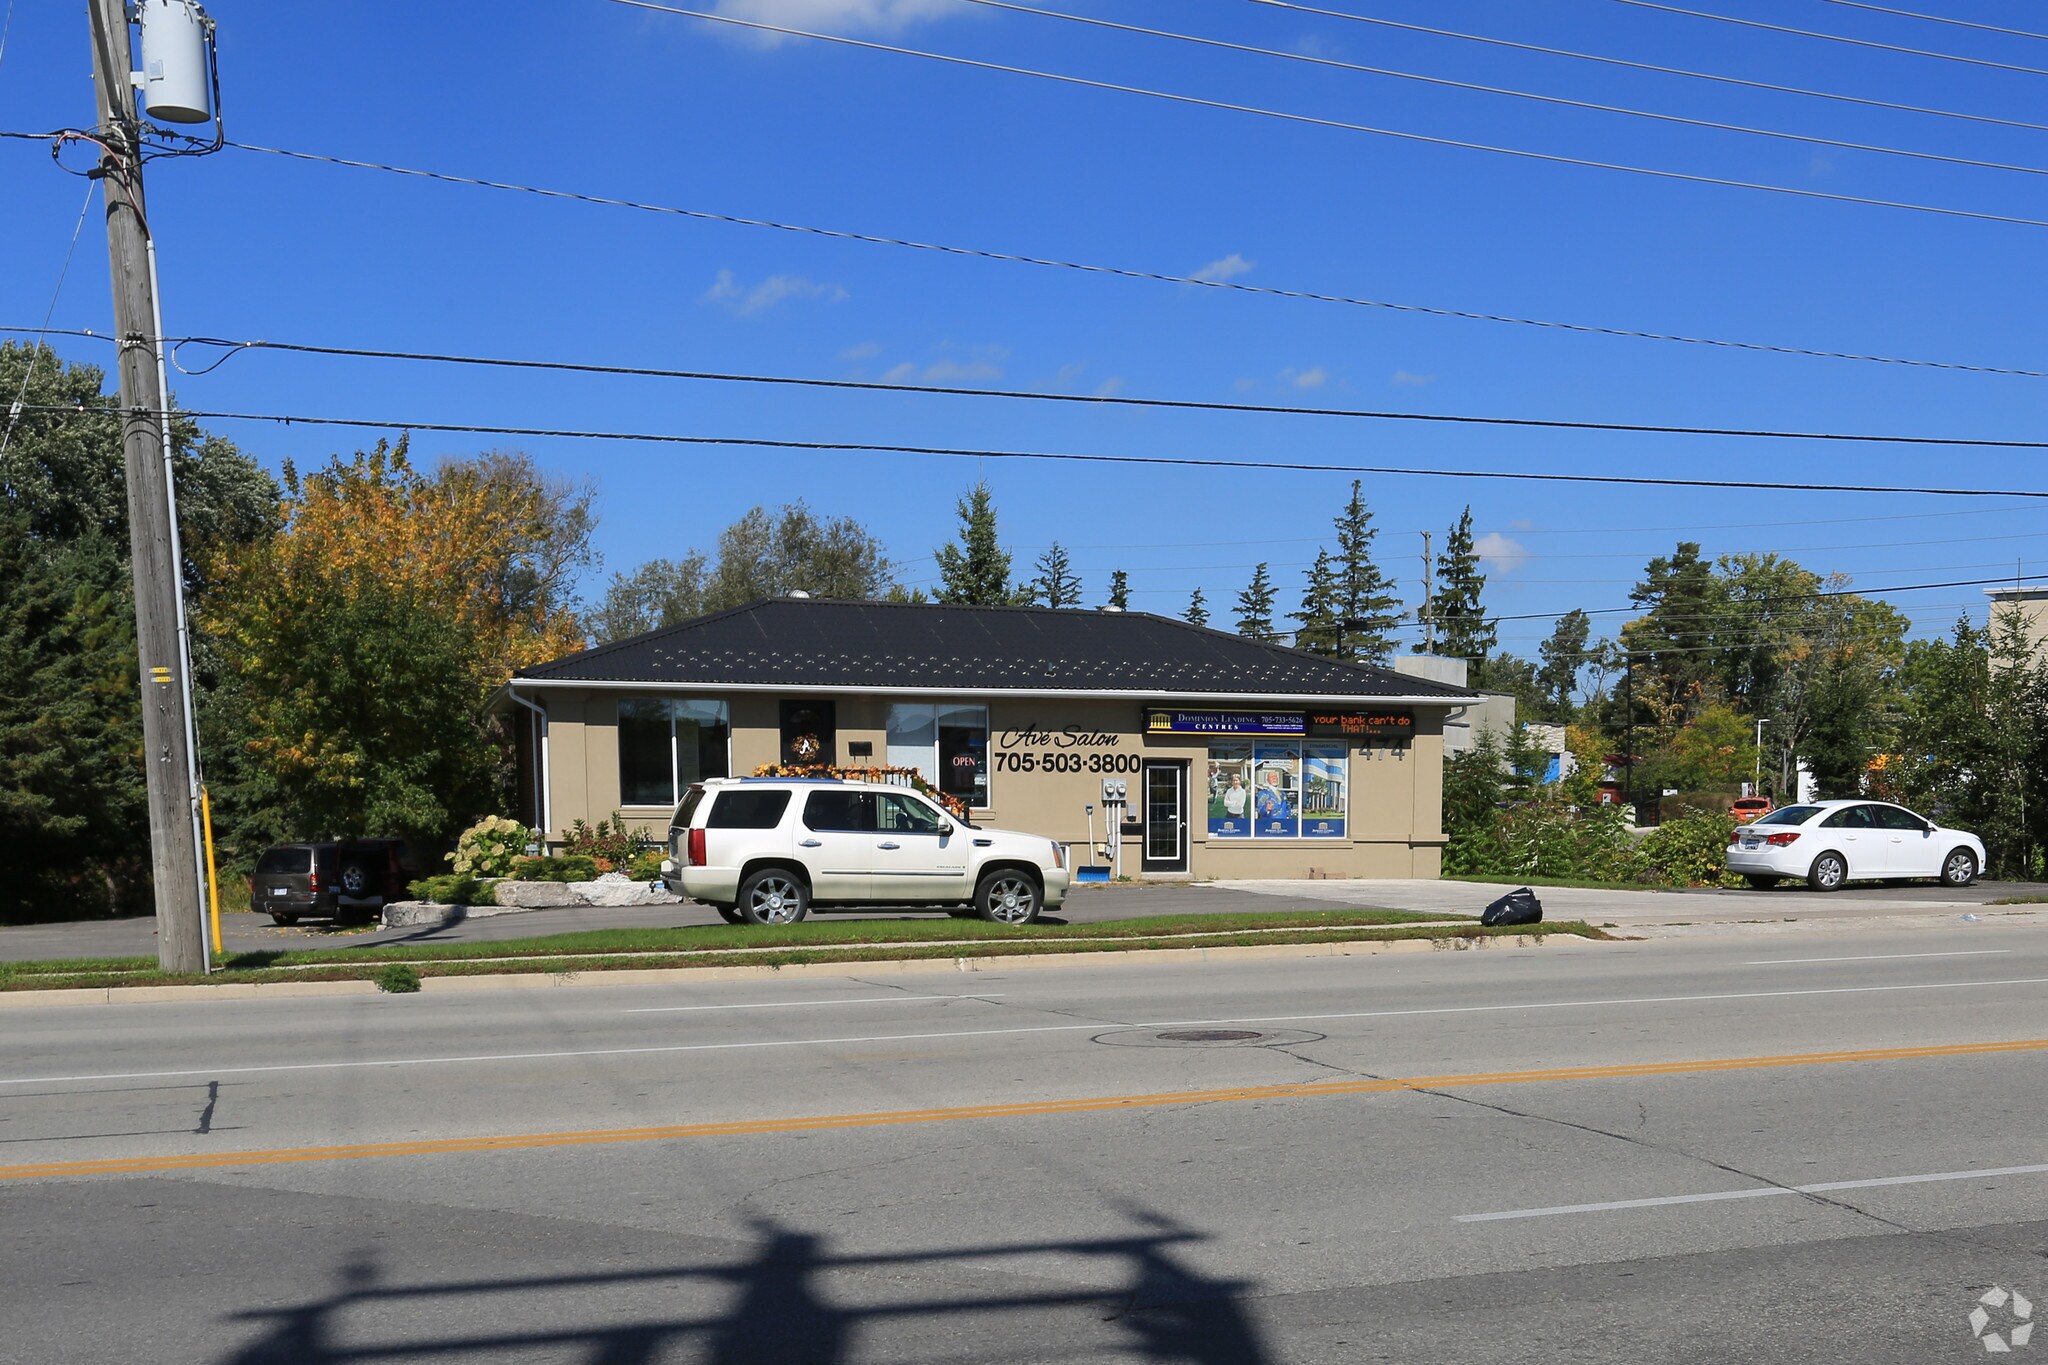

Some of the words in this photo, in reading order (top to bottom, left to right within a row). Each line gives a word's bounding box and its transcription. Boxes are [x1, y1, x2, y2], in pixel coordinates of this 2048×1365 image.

[1178, 714, 1218, 722] DOMINION
[1222, 714, 1256, 723] LENDING
[1313, 716, 1338, 725] your
[1340, 715, 1366, 725] bank
[1368, 716, 1395, 725] can't
[1398, 716, 1410, 726] do
[1054, 724, 1120, 748] Salon
[1358, 738, 1405, 761] 474
[952, 756, 976, 766] OPEN
